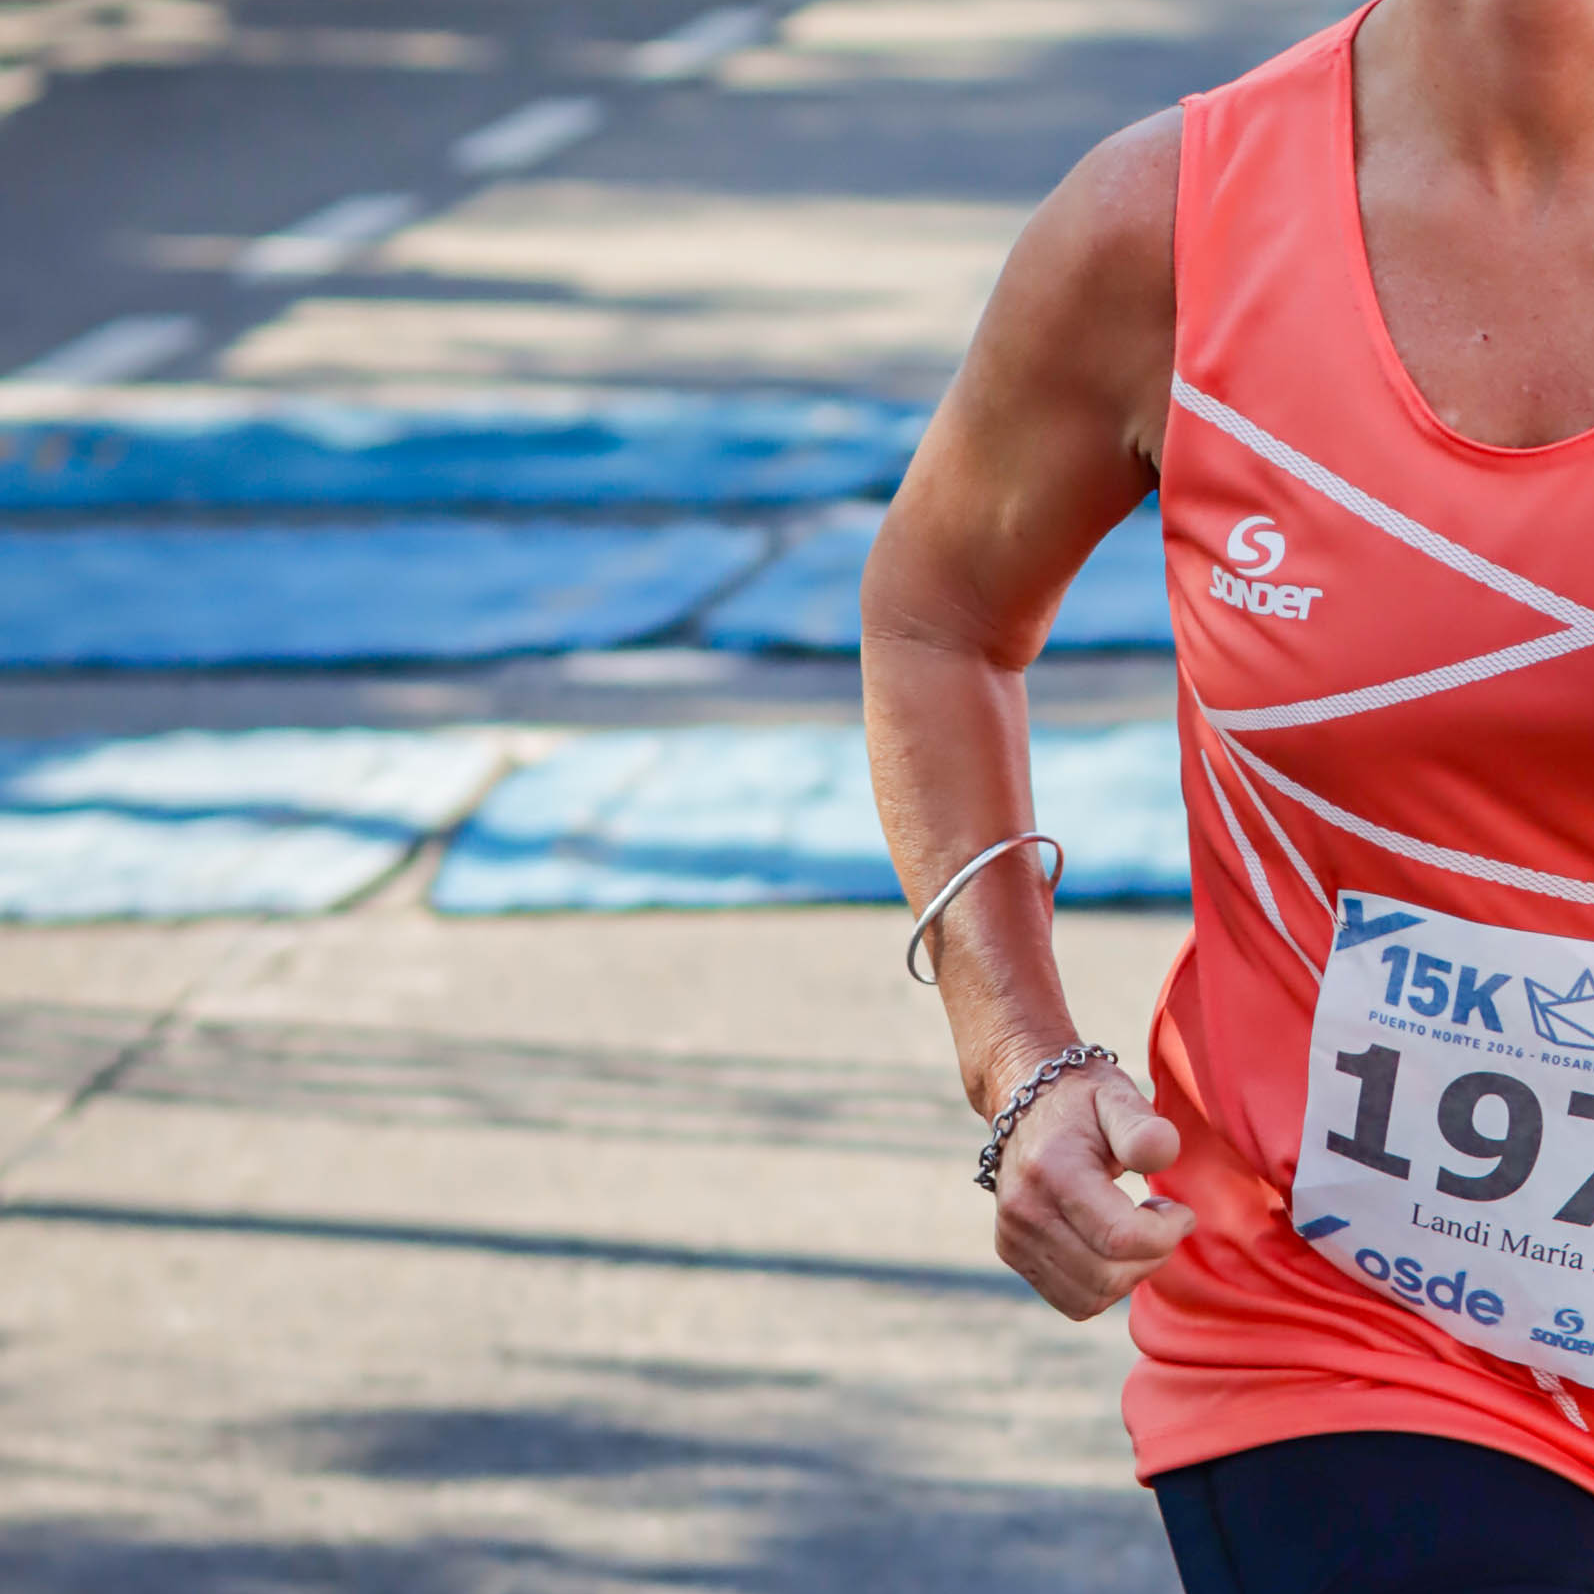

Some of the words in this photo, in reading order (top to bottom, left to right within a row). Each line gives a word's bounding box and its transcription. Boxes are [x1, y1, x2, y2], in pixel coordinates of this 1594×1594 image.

[1381, 944, 1513, 1034] 15K
[1368, 1010, 1427, 1037] PUERTO
[1431, 1028, 1481, 1050] NORTE
[1487, 1041, 1525, 1060] 2026
[1411, 1202, 1492, 1248] Landi
[1498, 1228, 1584, 1271] María
[1354, 1247, 1505, 1326] osde
